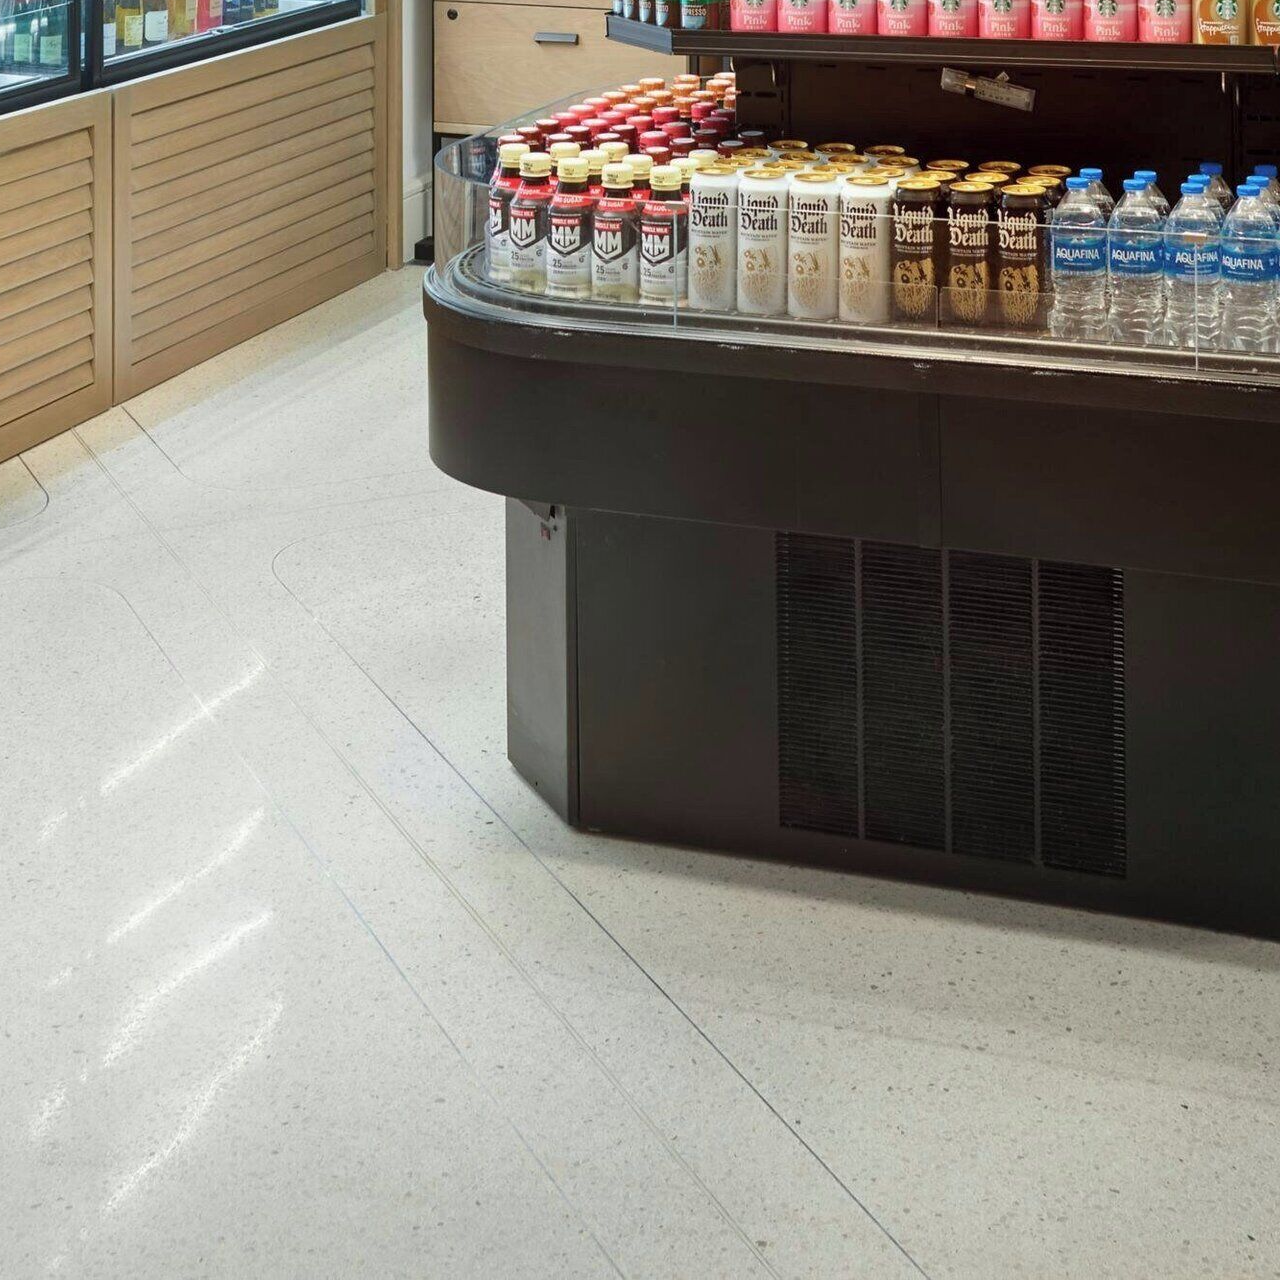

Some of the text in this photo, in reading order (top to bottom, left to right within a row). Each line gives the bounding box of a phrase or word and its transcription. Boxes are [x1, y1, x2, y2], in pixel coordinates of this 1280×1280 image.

[743, 15, 767, 25] Pink
[788, 16, 813, 26] Pink
[837, 17, 860, 28] Pink
[888, 20, 911, 30] Pink
[939, 21, 964, 31] Pink
[991, 22, 1015, 32] Pink
[1043, 22, 1067, 32] Pink
[1096, 26, 1120, 36] Pink
[1154, 26, 1178, 37] Pink
[692, 189, 728, 212] Liquid
[741, 193, 778, 216] Liquid
[791, 195, 828, 218] Liquid
[692, 210, 727, 228] Death
[842, 199, 877, 223] Liquid
[893, 203, 933, 228] Liquid
[947, 207, 988, 231] Liquid
[742, 213, 778, 231] Death
[792, 216, 827, 234] Death
[842, 220, 876, 238] Death
[998, 209, 1037, 234] Liquid
[895, 224, 933, 243] Death
[949, 227, 988, 246] Death
[999, 230, 1037, 249] Death
[1056, 248, 1100, 260] AQUAFINA
[1112, 249, 1155, 262] AQUAFINA
[1176, 251, 1218, 262] AQUAFINA
[1222, 256, 1263, 270] AQUAFINA
